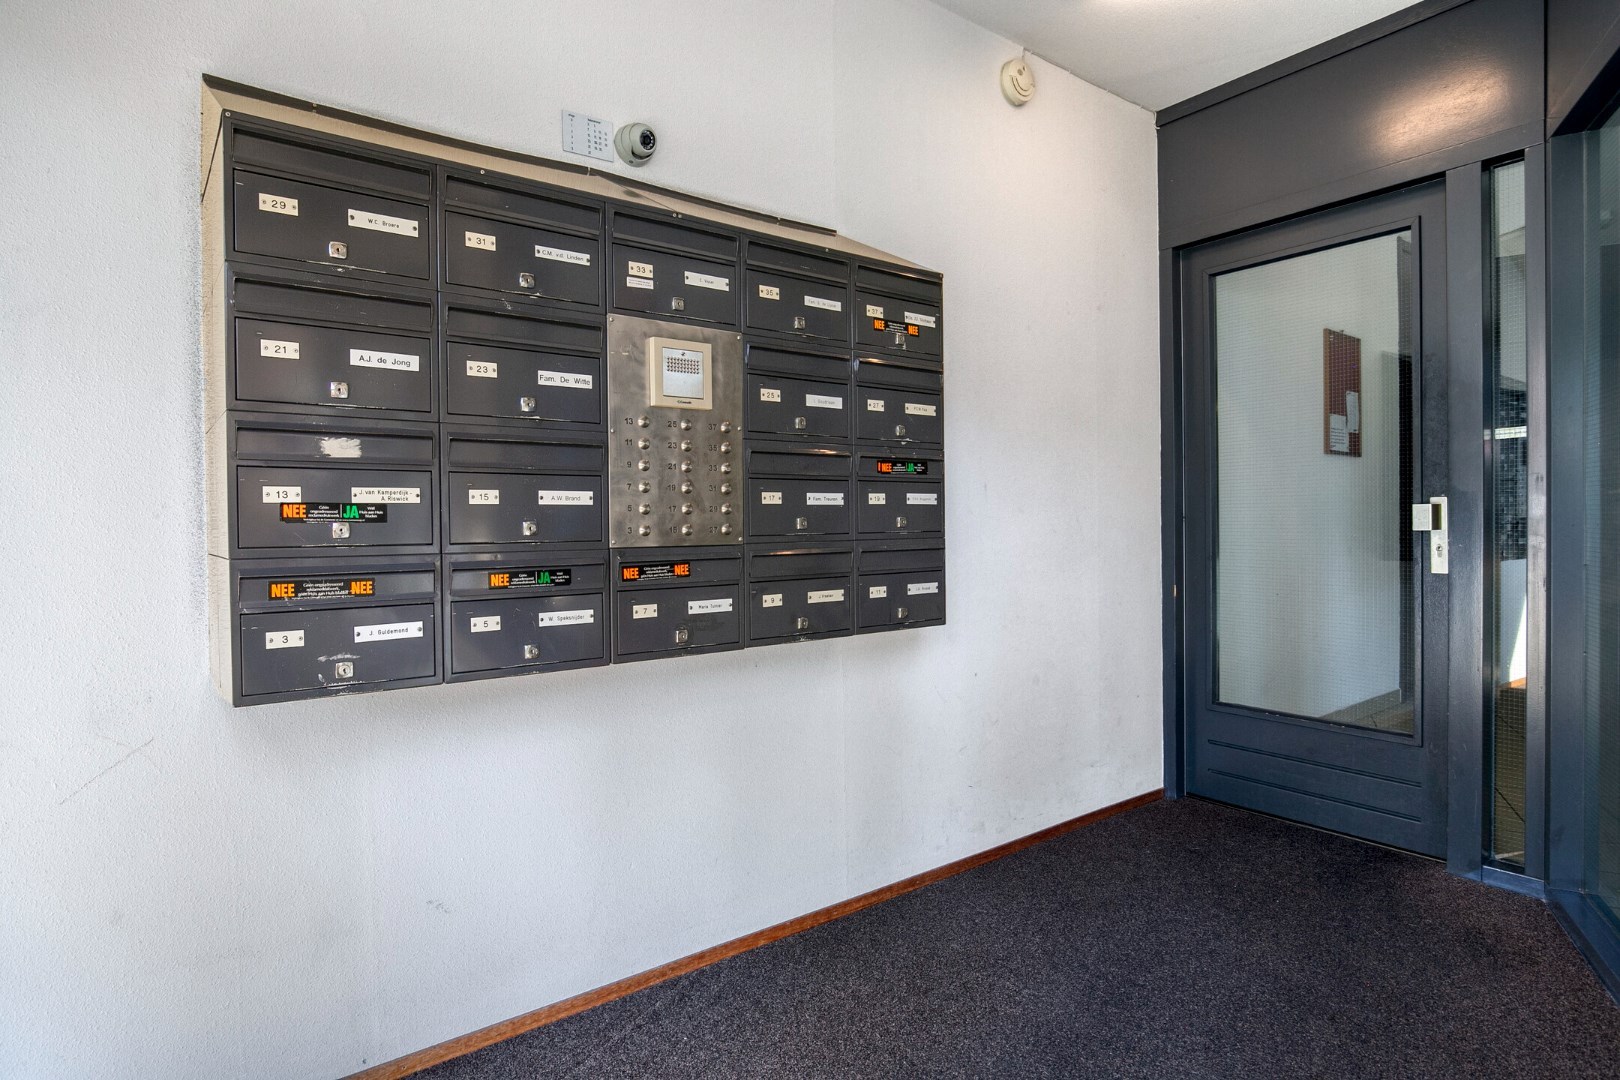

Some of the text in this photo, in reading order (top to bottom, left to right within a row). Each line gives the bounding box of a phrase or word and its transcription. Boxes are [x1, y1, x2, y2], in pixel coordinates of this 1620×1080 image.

[272, 200, 286, 209] 29
[874, 319, 885, 330] NEE
[908, 325, 918, 335] NEE
[275, 345, 286, 354] 21
[392, 358, 410, 367] Jong
[882, 463, 892, 472] NEE
[283, 504, 307, 518] NEE
[343, 505, 359, 518] JA
[624, 568, 639, 579] NEE
[674, 564, 689, 575] NEE
[491, 574, 510, 586] NEE
[538, 572, 550, 584] JA
[271, 583, 295, 598] NEE
[351, 581, 373, 594] NEE
